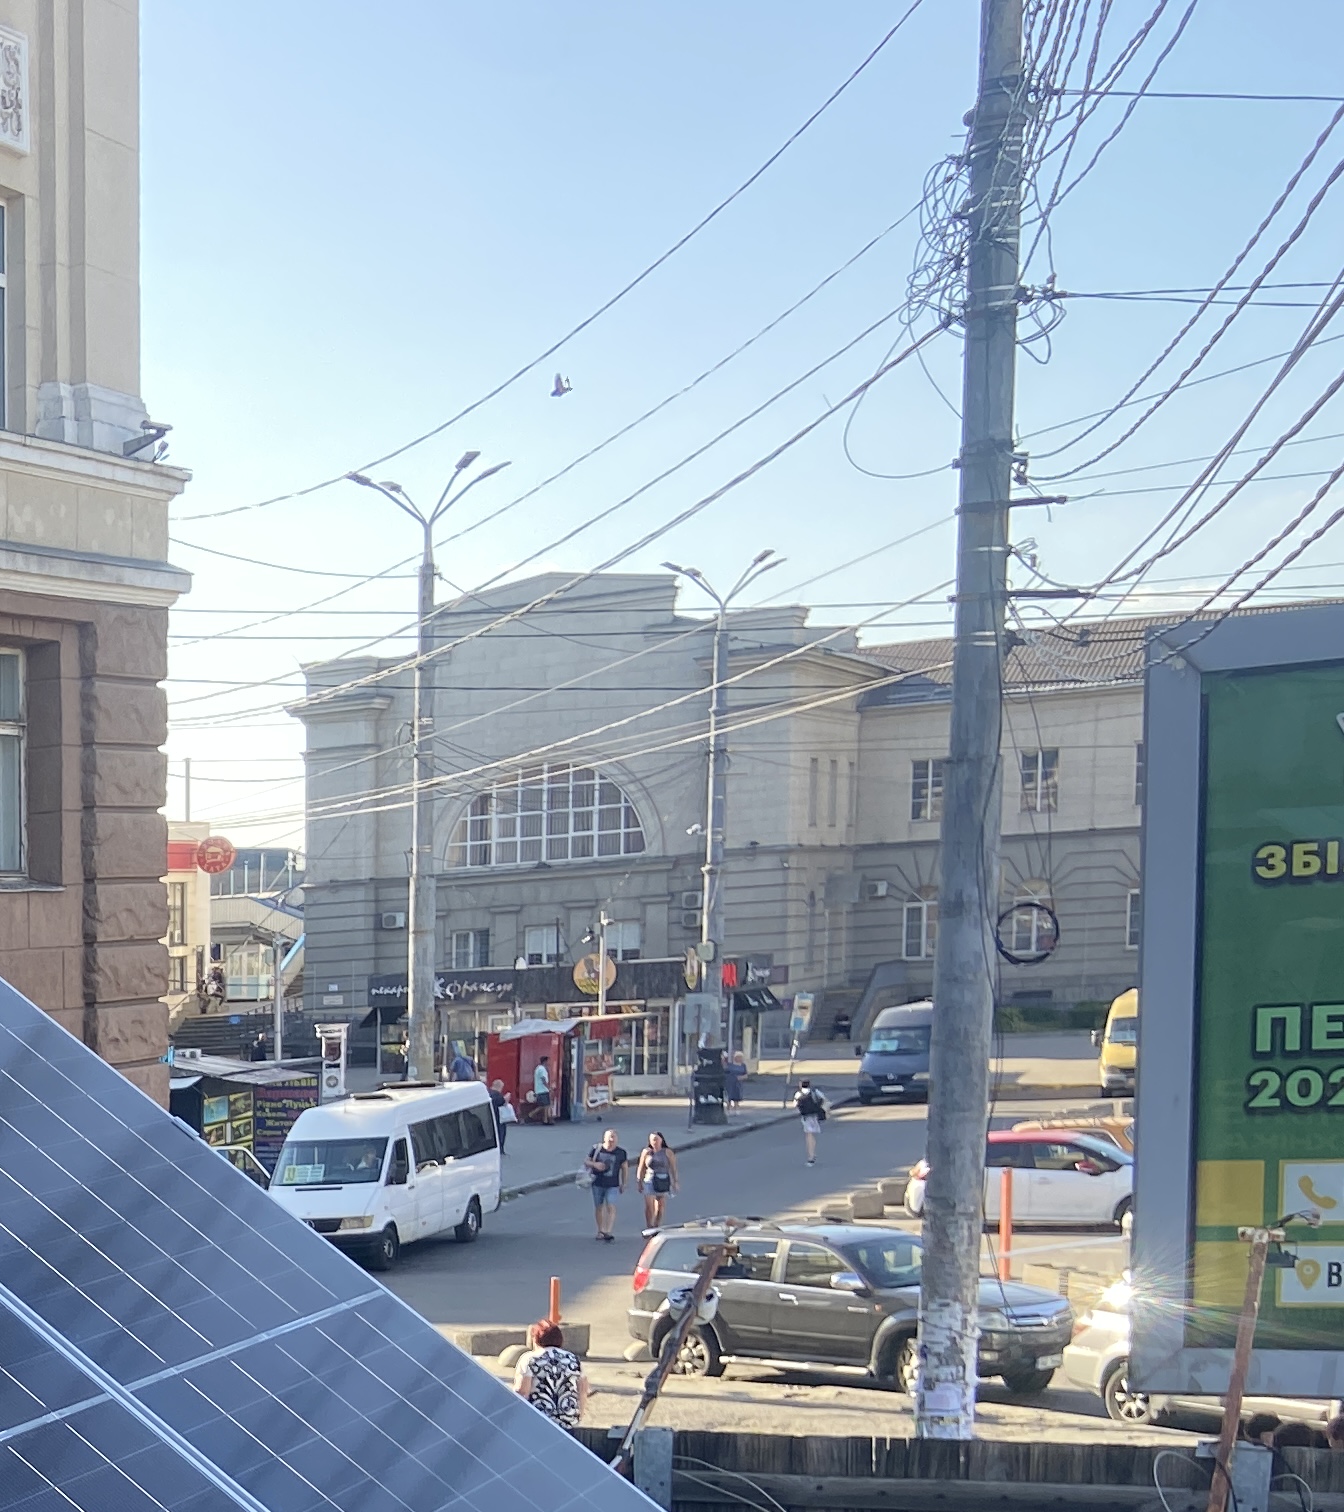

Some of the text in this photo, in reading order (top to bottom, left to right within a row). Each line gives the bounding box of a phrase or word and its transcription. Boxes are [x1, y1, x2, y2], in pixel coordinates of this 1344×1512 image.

[1255, 841, 1343, 879] ЗБІ
[1255, 1004, 1343, 1052] ПЕ
[1327, 1261, 1343, 1288] В
